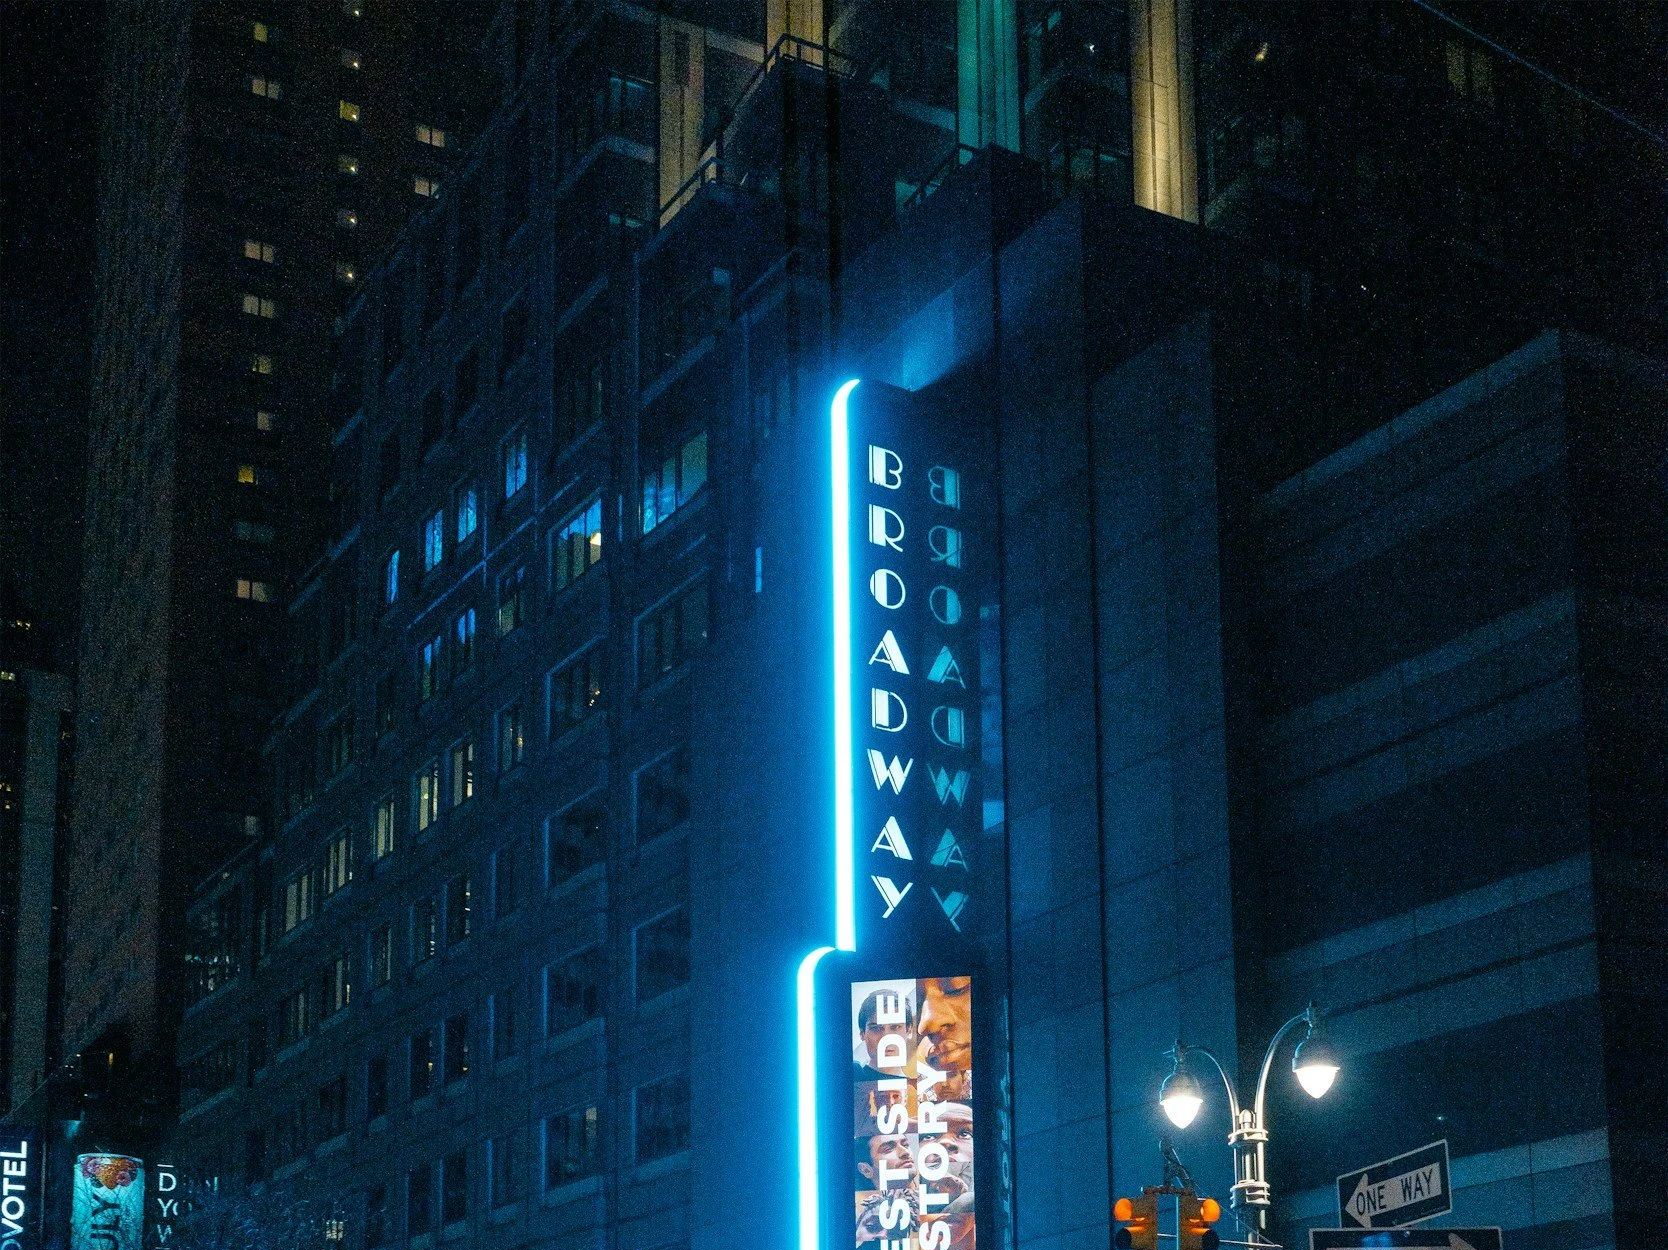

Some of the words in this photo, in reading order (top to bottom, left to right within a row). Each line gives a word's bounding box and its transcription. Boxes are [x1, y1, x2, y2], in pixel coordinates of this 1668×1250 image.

[868, 444, 914, 919] BROADWAY
[877, 994, 909, 1136] SIDE
[1356, 1185, 1387, 1216] ONE
[1400, 1168, 1434, 1202] WAY
